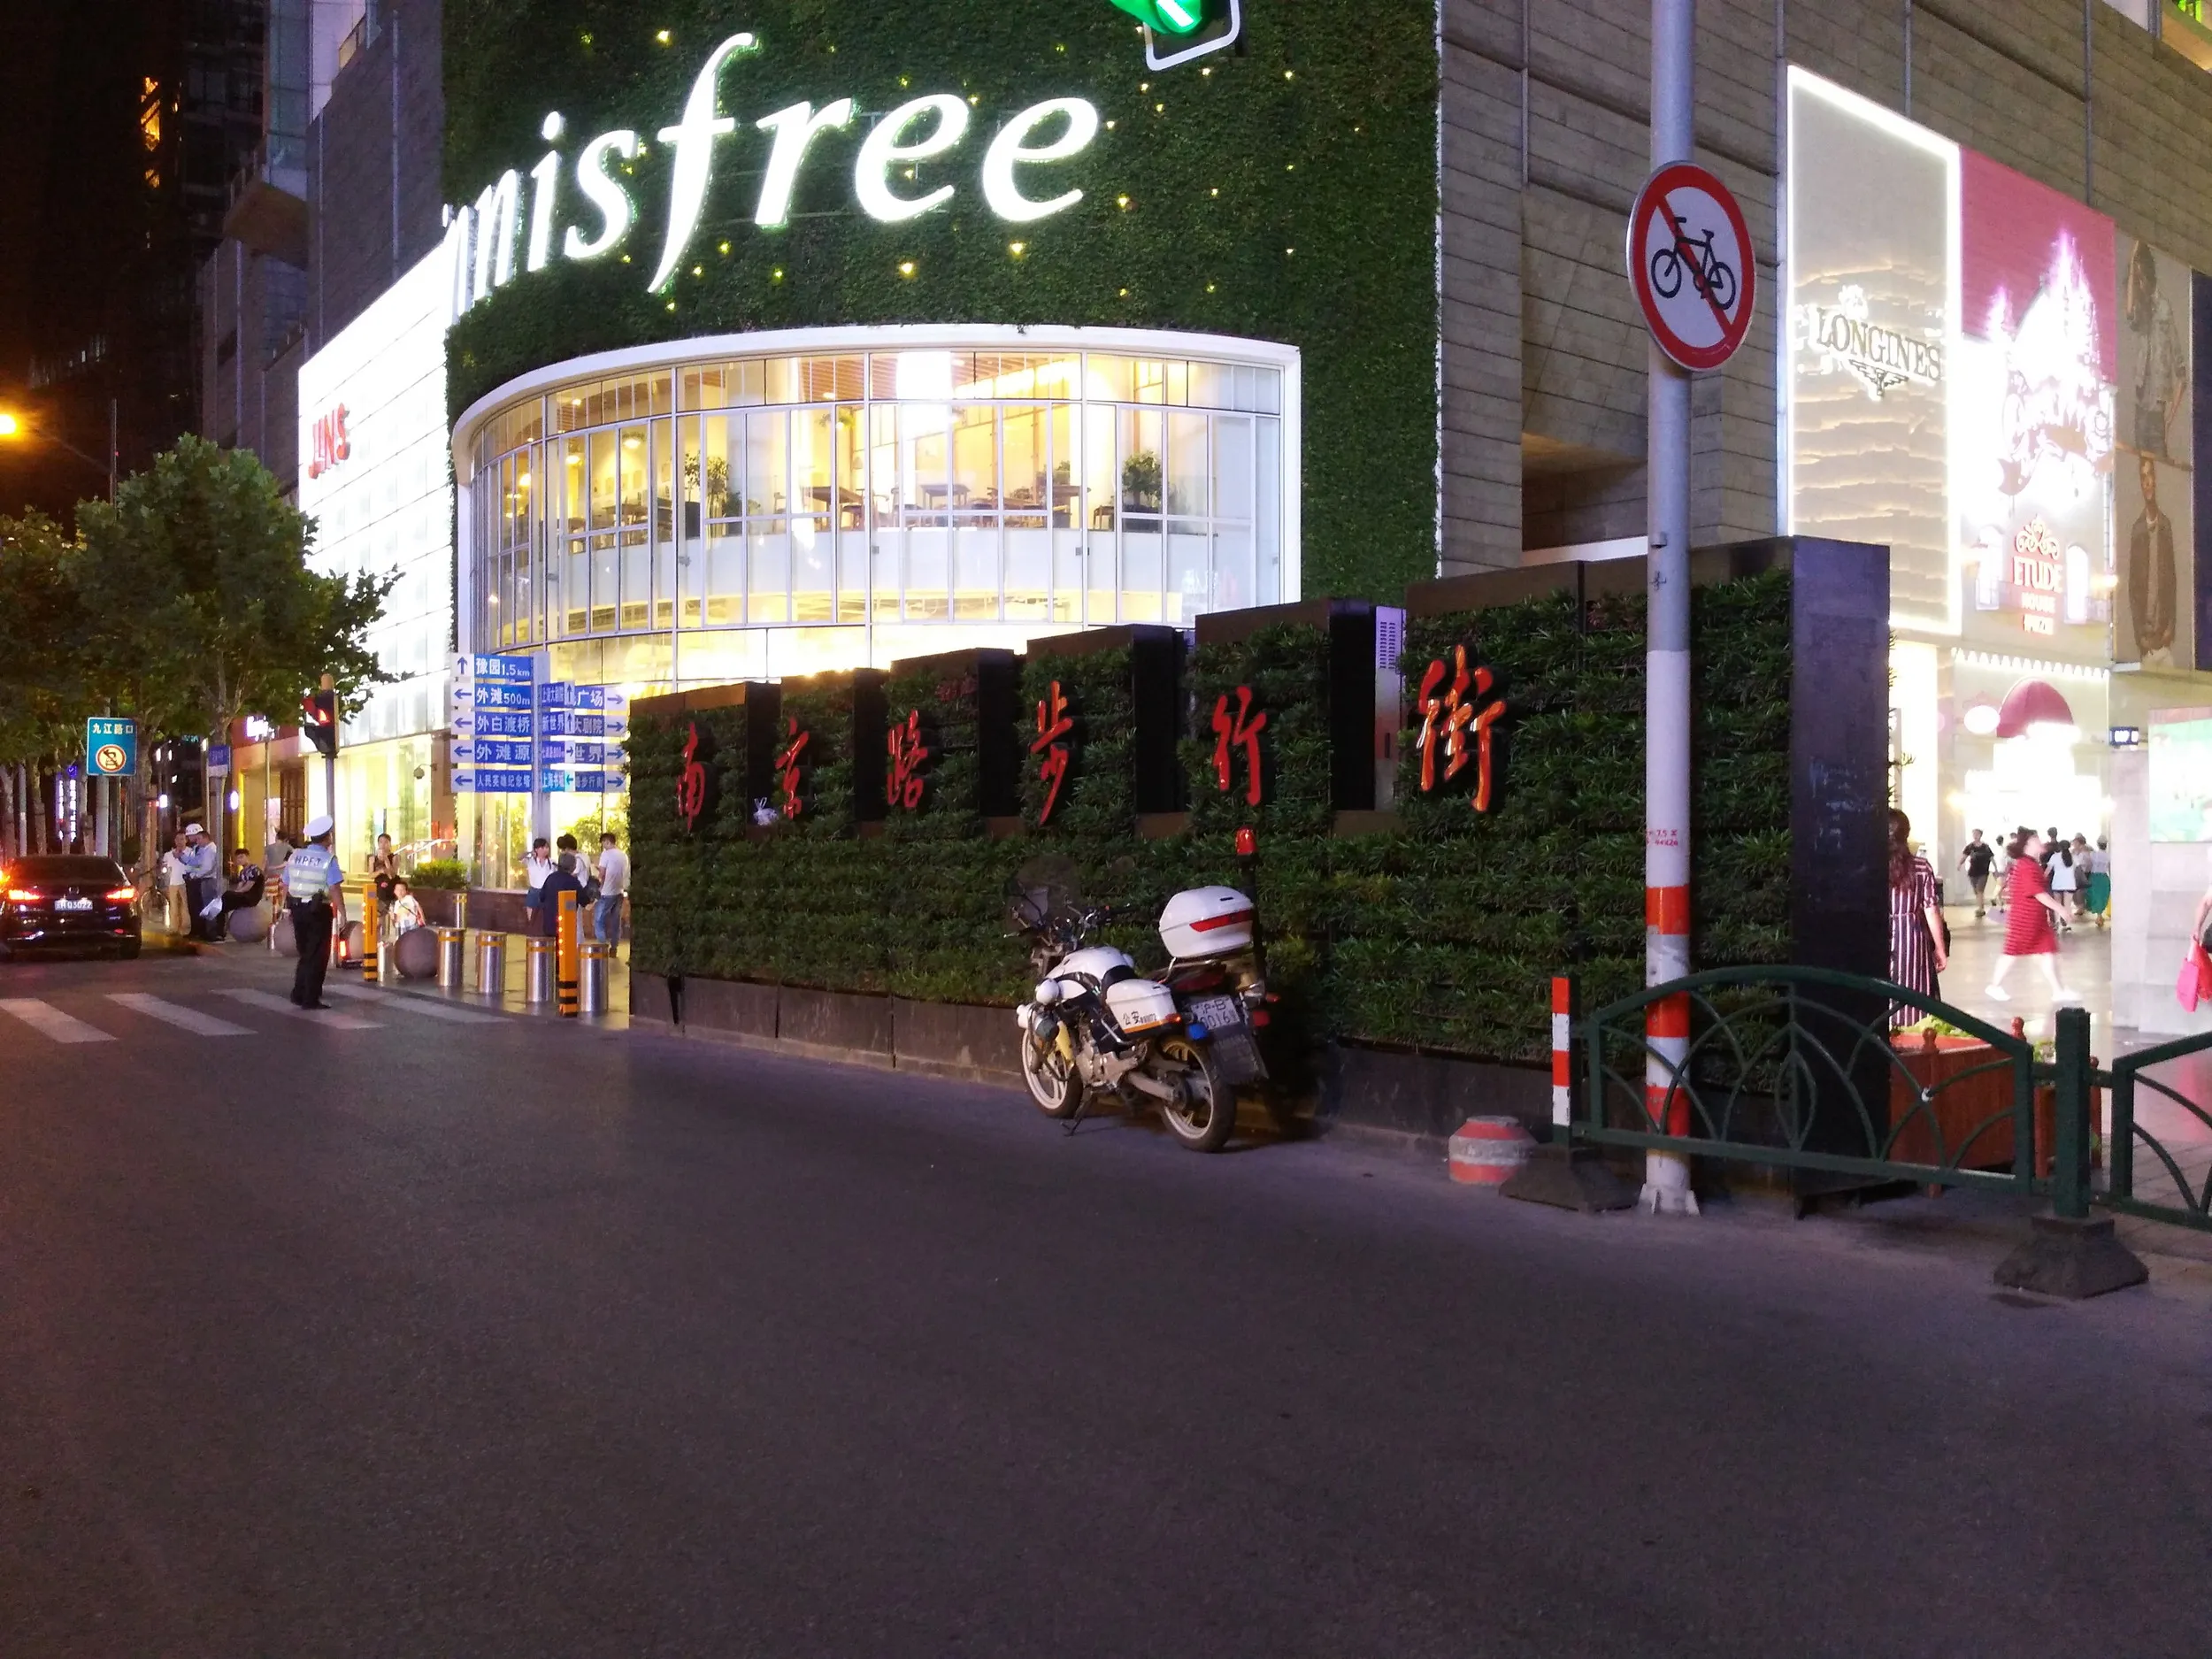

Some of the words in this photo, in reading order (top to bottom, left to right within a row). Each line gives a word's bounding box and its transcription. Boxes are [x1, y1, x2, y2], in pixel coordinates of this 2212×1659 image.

[441, 33, 1102, 326] nnisfree
[1816, 306, 1942, 381] LONGINES
[308, 402, 351, 480] JINS
[2012, 556, 2064, 594] ETUDE
[573, 689, 603, 707] 广场
[92, 722, 134, 735] 九江路口
[476, 715, 531, 733] 外白渡桥
[476, 743, 531, 762] 外滩源
[476, 774, 531, 788] 人民英雄纪念塔
